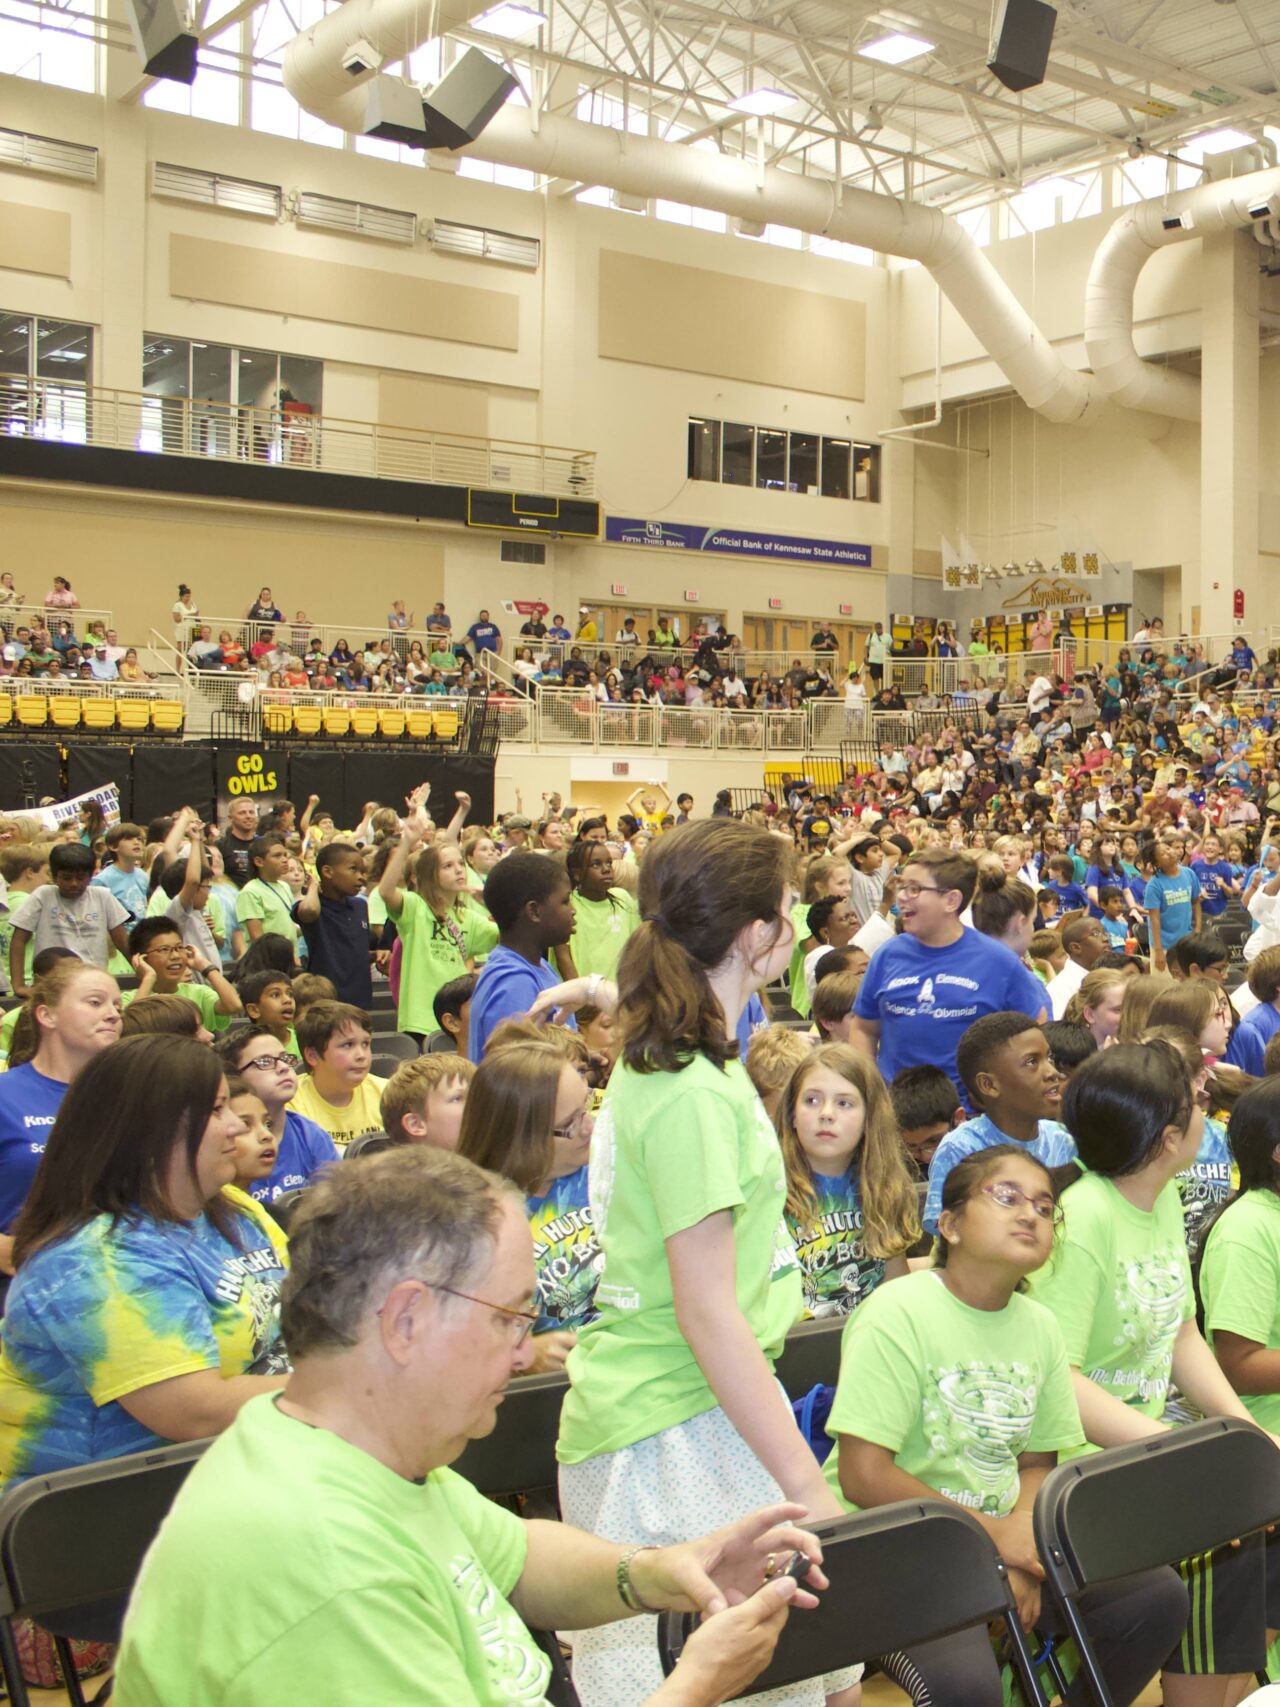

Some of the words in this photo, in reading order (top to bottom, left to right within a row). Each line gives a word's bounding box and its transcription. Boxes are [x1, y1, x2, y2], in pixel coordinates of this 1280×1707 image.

[519, 518, 539, 527] PERIOD
[622, 535, 641, 544] FIFTH
[643, 537, 665, 546] THIRD
[666, 540, 686, 548] BANK
[712, 536, 741, 548] Official
[743, 539, 762, 550] Bank
[764, 540, 773, 551] of
[774, 543, 812, 555] Kennesaw
[813, 547, 833, 558] State
[834, 550, 867, 561] Athletics
[236, 753, 263, 774] GO
[227, 771, 278, 795] OWLS
[935, 973, 979, 991] Elementary
[933, 1005, 977, 1019] Olympiad
[24, 1115, 57, 1128] Kno
[536, 1256, 571, 1299] NO
